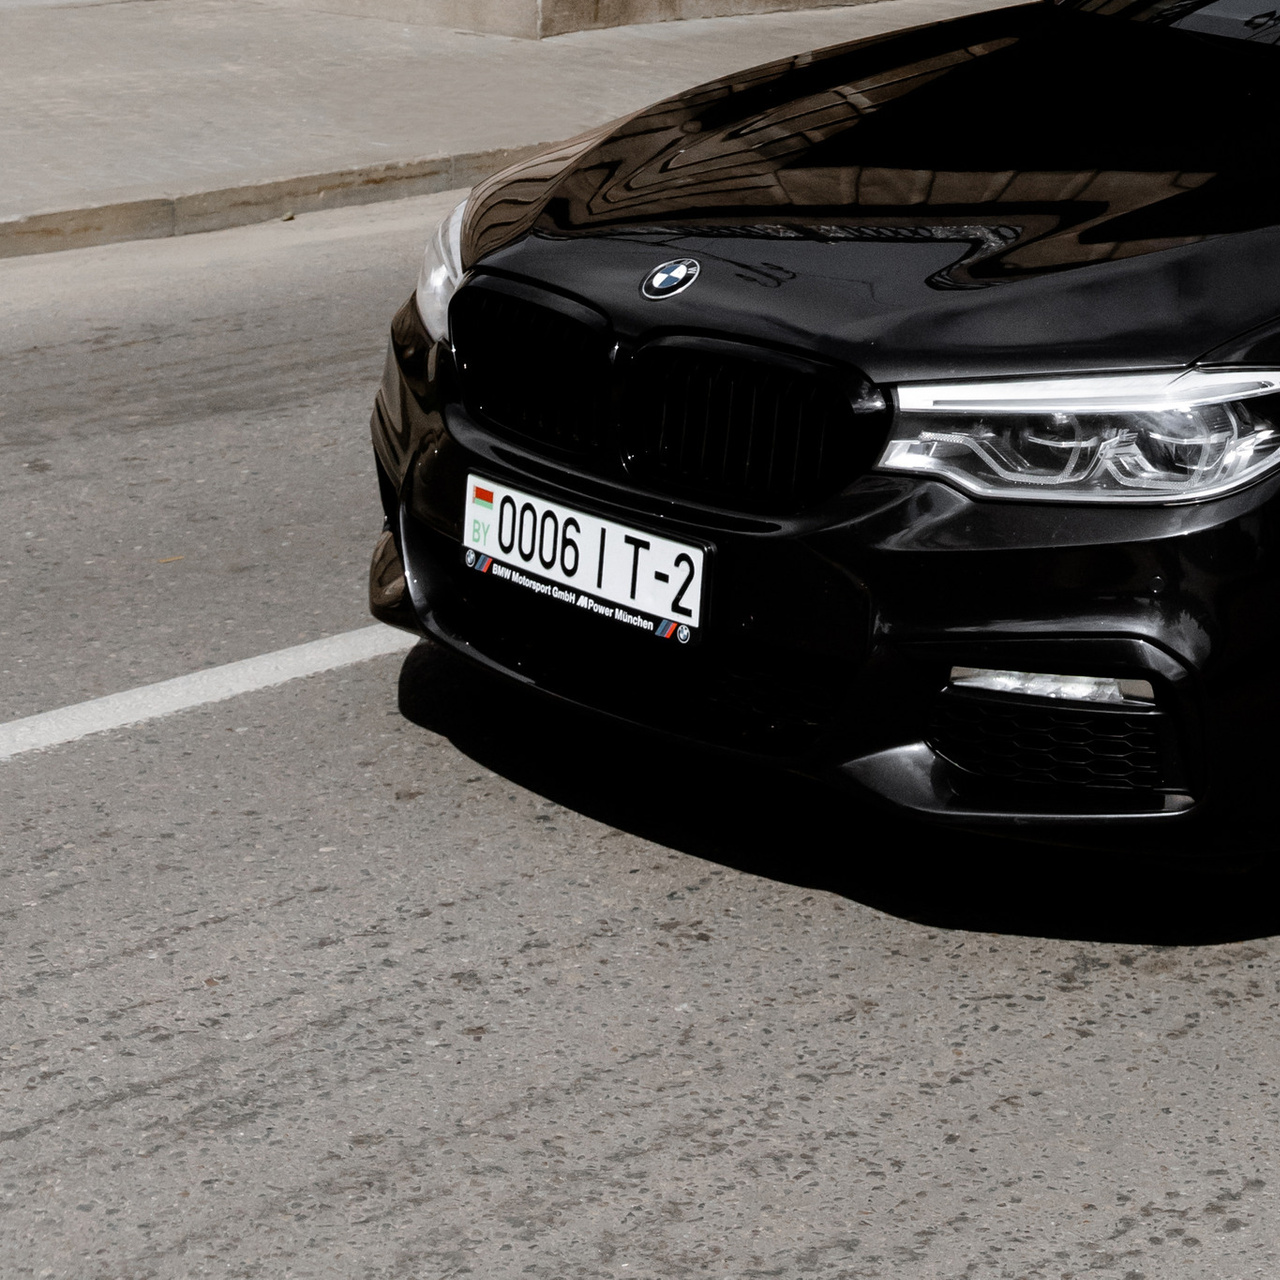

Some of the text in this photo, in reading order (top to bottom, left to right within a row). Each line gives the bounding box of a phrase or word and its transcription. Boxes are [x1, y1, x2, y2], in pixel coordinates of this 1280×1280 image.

[472, 519, 490, 546] BY
[498, 495, 581, 577] 0006
[492, 563, 511, 580] BMW
[511, 571, 551, 595] Motorsport
[552, 586, 576, 605] GmbH
[614, 607, 654, 631] München
